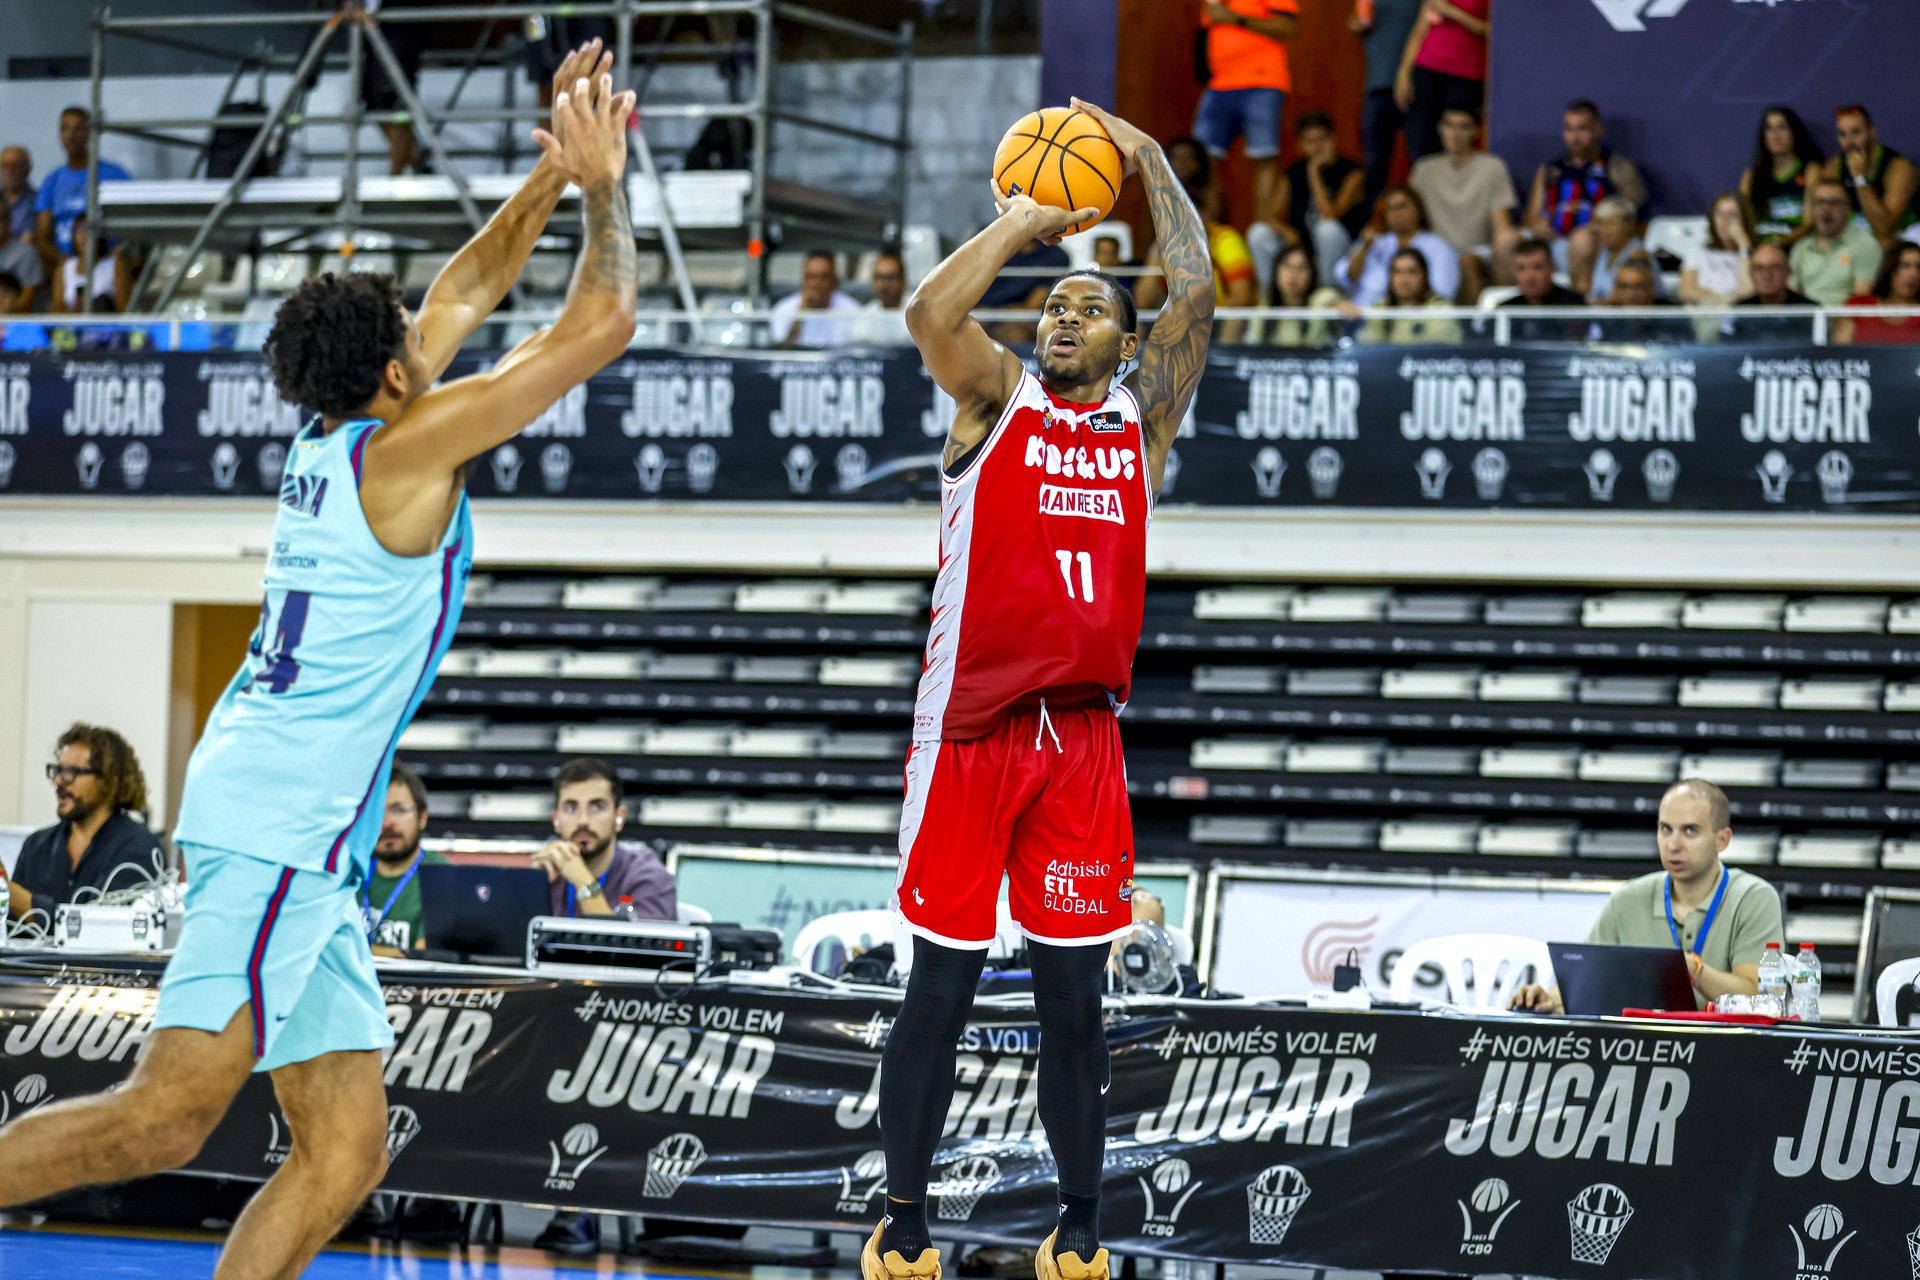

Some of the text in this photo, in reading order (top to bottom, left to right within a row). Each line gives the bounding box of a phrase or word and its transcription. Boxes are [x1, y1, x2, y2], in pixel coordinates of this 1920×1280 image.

[63, 376, 165, 436] JUGAR
[621, 375, 734, 437] JUGAR
[769, 375, 885, 438] JUGAR
[1236, 375, 1361, 440] JUGAR
[1400, 376, 1527, 441] JUGAR
[1567, 376, 1698, 442] JUGAR
[1740, 377, 1872, 443] JUGAR
[1055, 549, 1095, 603] 11
[1044, 874, 1079, 898] ETL
[1046, 859, 1110, 878] Adbisio
[1044, 893, 1109, 914] GLOBAL
[5, 985, 158, 1062] JUGA
[421, 986, 505, 1010] VOLEM
[574, 990, 785, 1035] #NOMÉS VOLEM
[546, 1020, 776, 1119] JUGAR
[986, 1028, 1042, 1055] VOL
[1154, 1025, 1378, 1060] #NOMÉS VOLEM
[1459, 1026, 1696, 1064] #NOMÉS VOLEM
[1784, 1038, 1920, 1077] #NOMÉS
[1134, 1055, 1371, 1148] JUGAR
[1444, 1060, 1691, 1167] JUGAR
[1773, 1075, 1920, 1186] JUG
[1460, 1243, 1493, 1256] FCBQ
